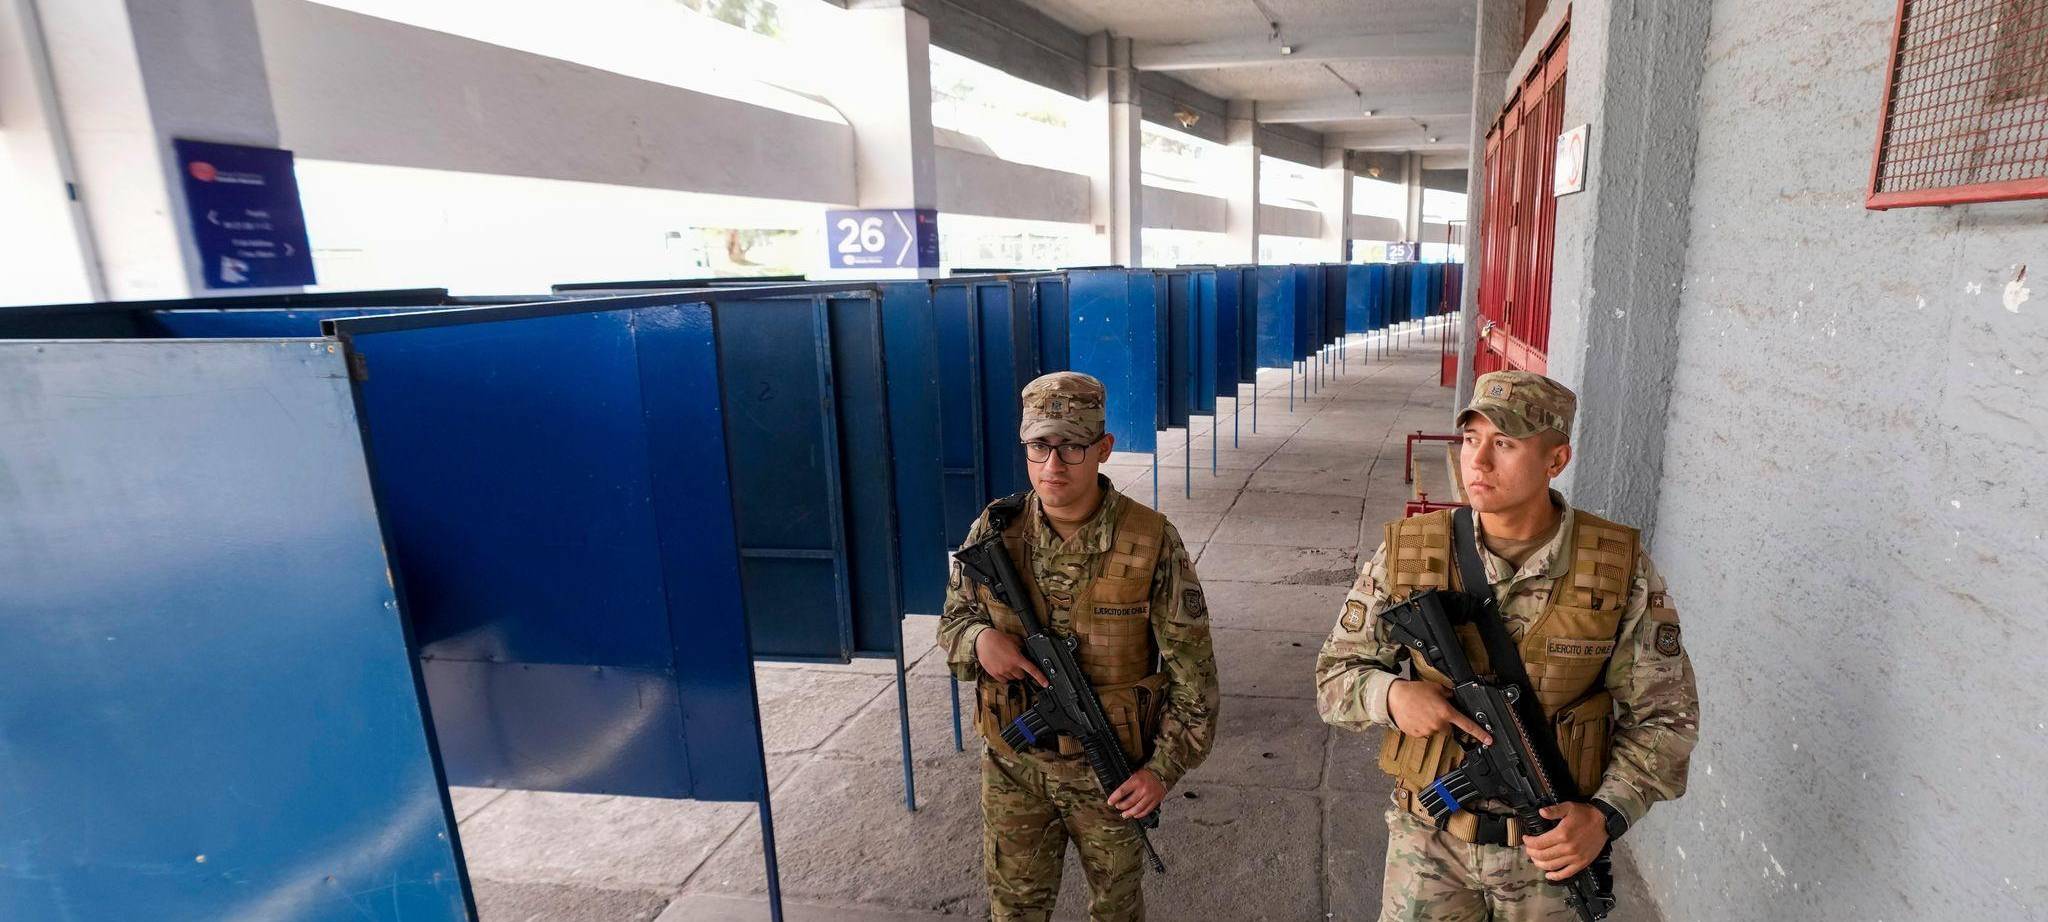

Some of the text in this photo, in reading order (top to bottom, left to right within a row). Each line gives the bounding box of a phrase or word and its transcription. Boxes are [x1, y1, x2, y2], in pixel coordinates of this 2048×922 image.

[837, 217, 886, 253] 26
[1390, 245, 1405, 257] 25
[1094, 606, 1147, 616] EJERCITO DE CHILE
[1549, 643, 1612, 656] EJERCITO DE CHILE
